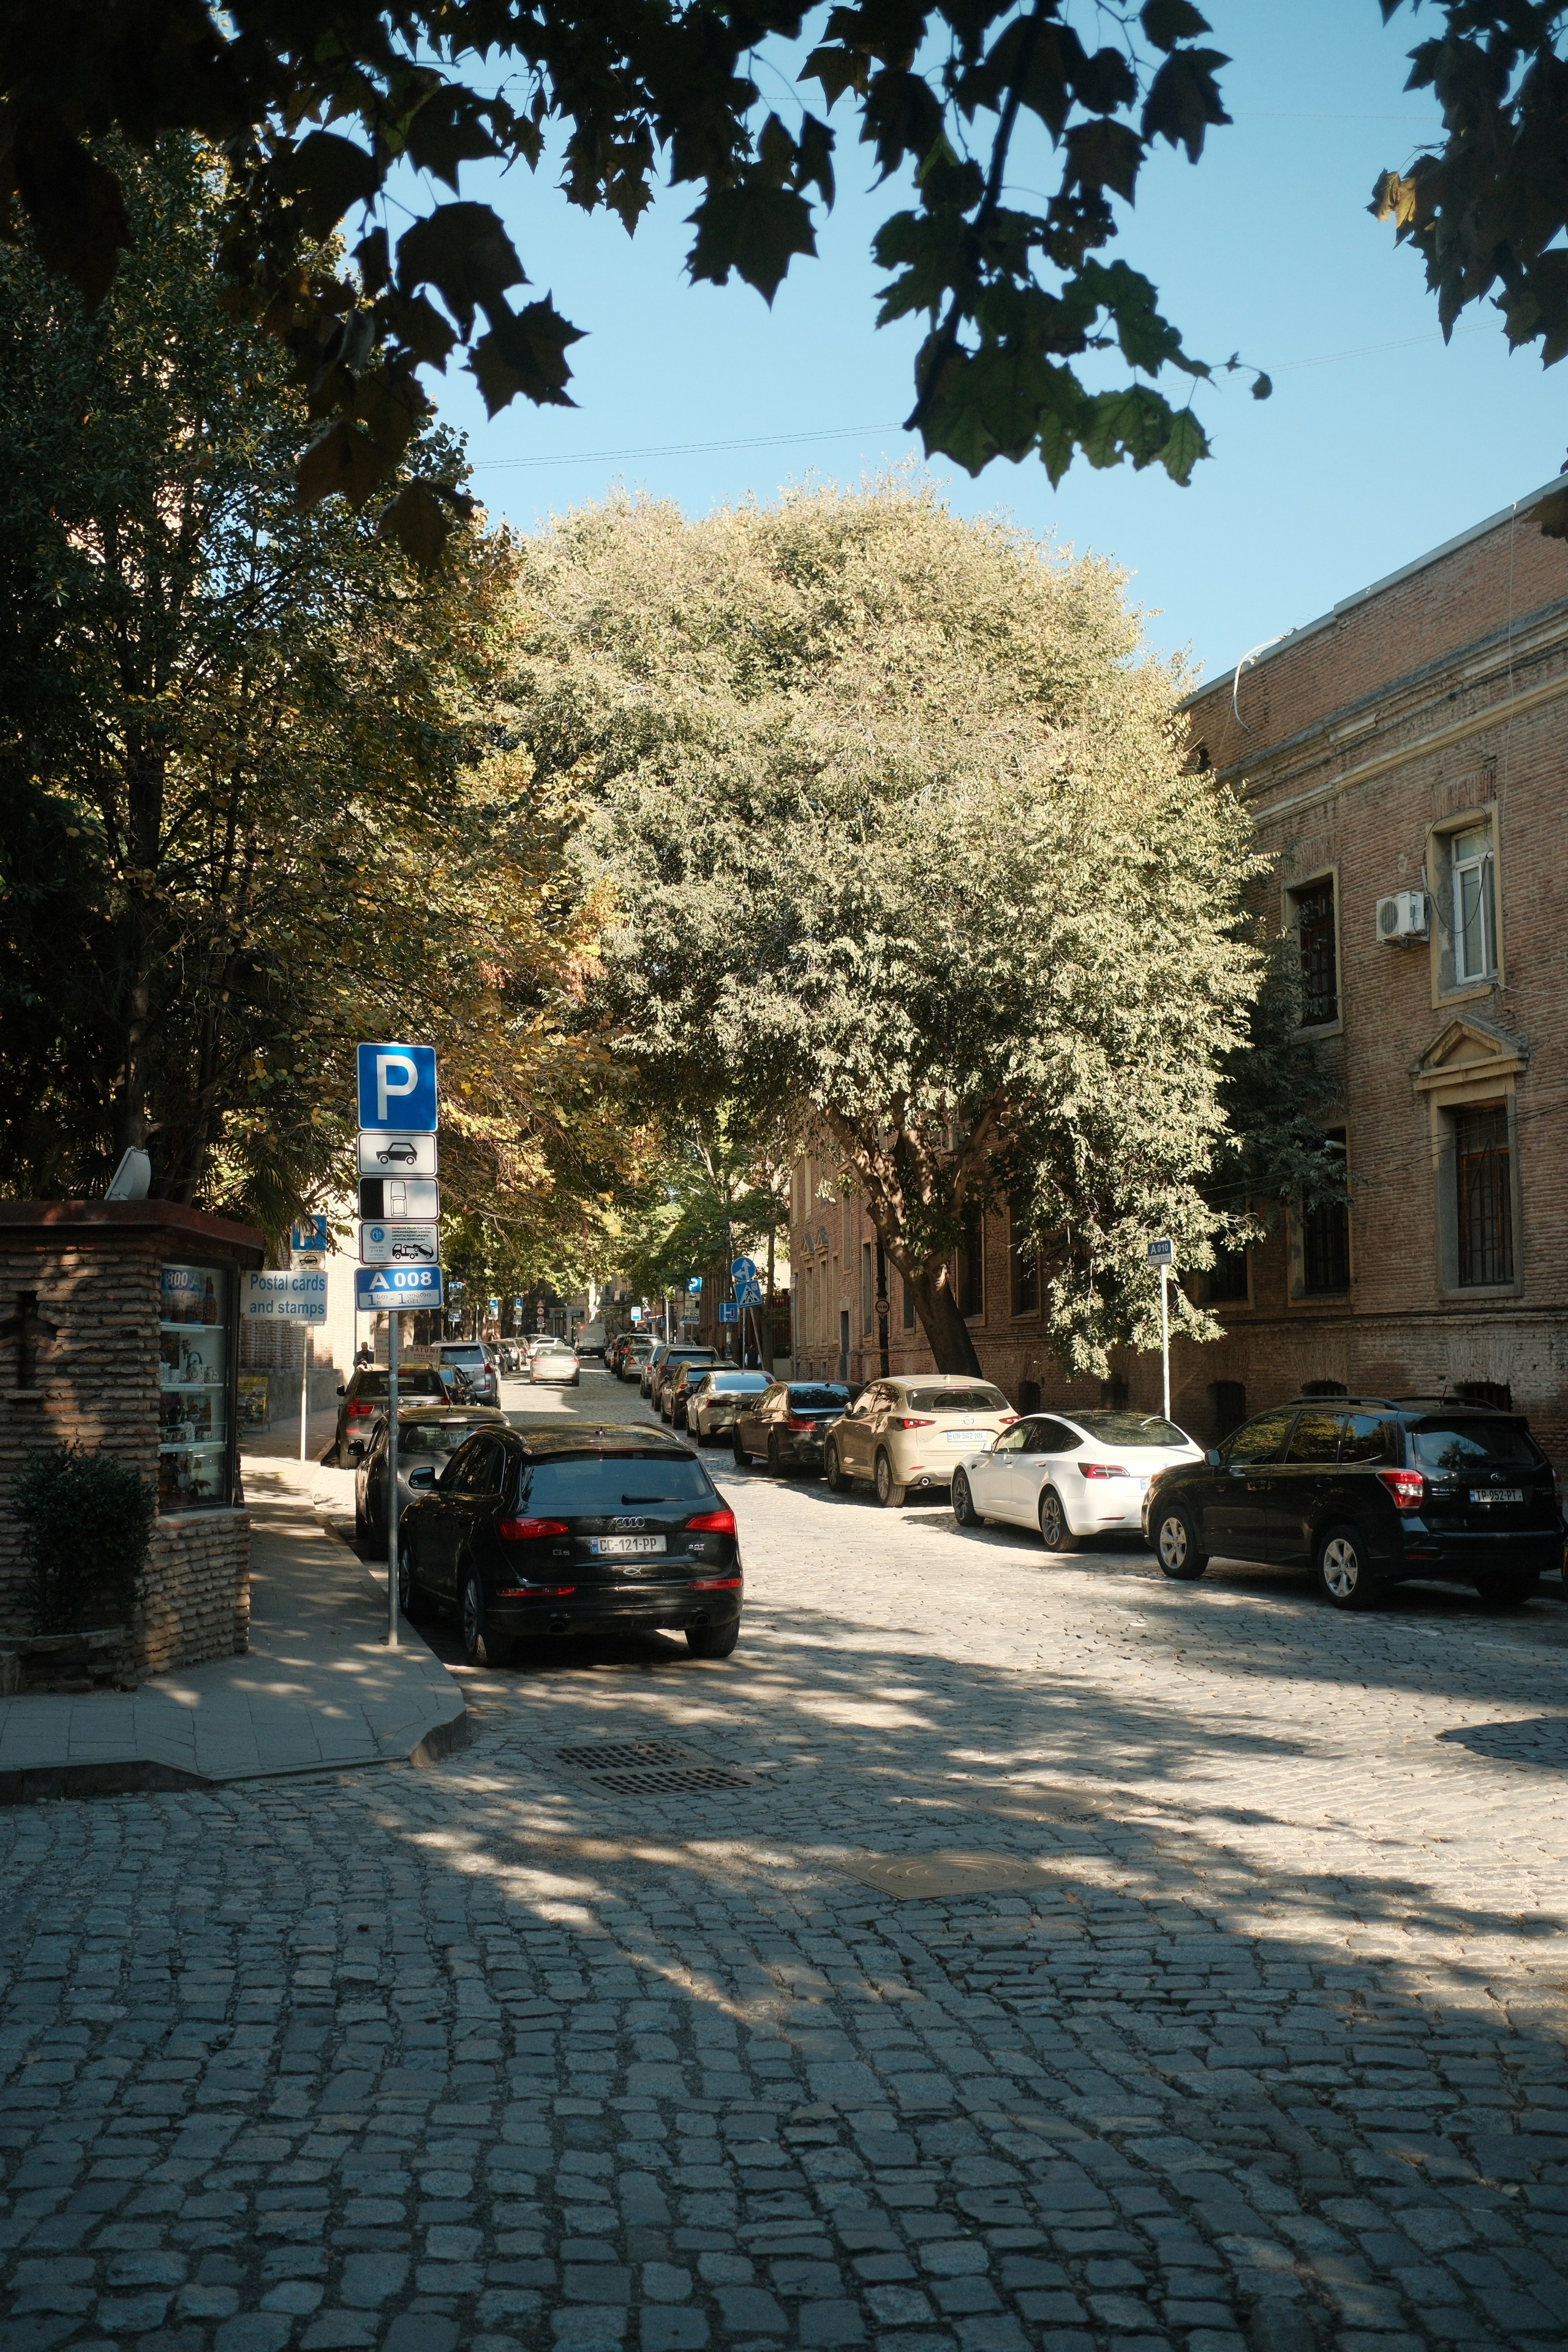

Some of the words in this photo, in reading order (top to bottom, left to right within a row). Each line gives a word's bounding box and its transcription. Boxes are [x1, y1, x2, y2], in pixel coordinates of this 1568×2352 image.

[376, 1054, 418, 1120] P
[1151, 1245, 1156, 1254] A
[1158, 1243, 1168, 1253] 010
[251, 1273, 288, 1291] Postal
[292, 1275, 325, 1291] cards
[369, 1272, 390, 1290] A
[394, 1272, 432, 1287] 008
[368, 1294, 376, 1306] 1
[398, 1294, 406, 1305] 1
[250, 1300, 274, 1314] and
[277, 1300, 325, 1317] stamps
[1476, 1490, 1517, 1501] TP-952-PT
[600, 1537, 657, 1552] CC-121-PP
